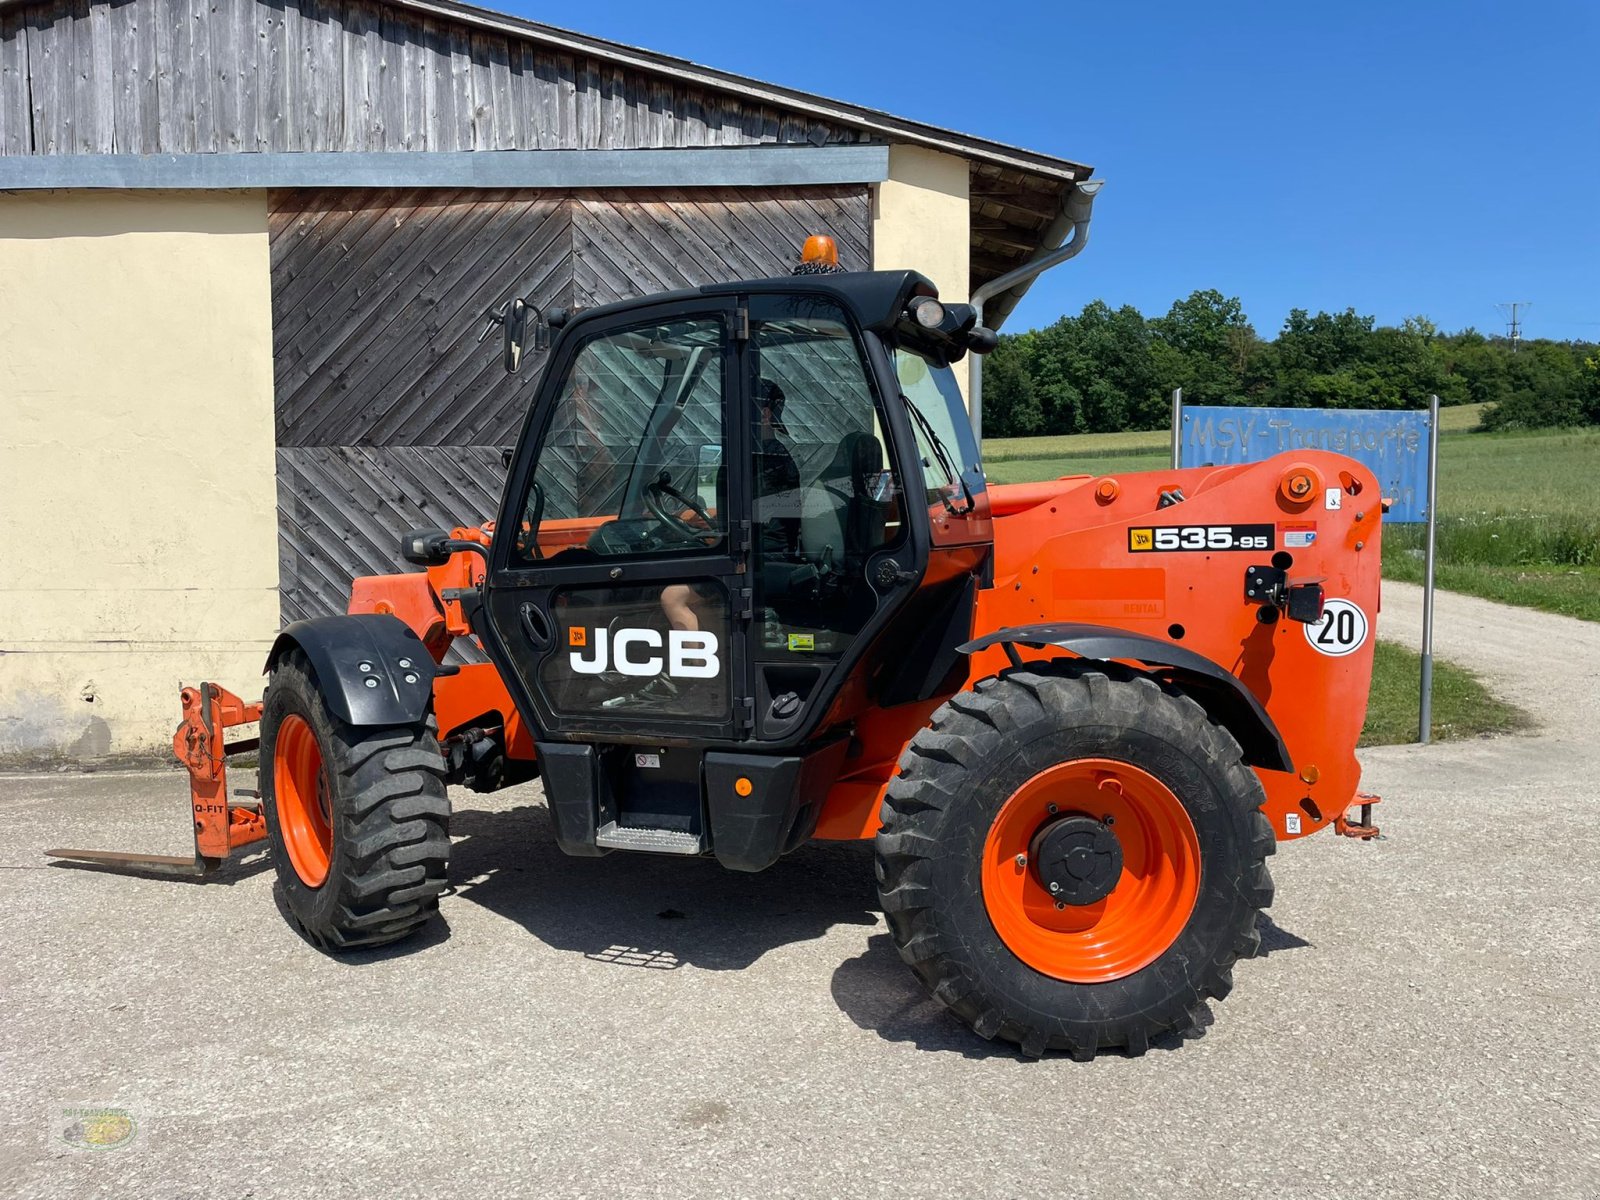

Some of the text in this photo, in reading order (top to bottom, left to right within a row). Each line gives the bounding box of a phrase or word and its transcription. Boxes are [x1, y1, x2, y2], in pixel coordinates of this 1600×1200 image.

[1123, 603, 1159, 614] RENTAL
[1317, 609, 1355, 645] 20
[570, 627, 720, 679] JCB
[195, 804, 224, 813] Q-FIT
